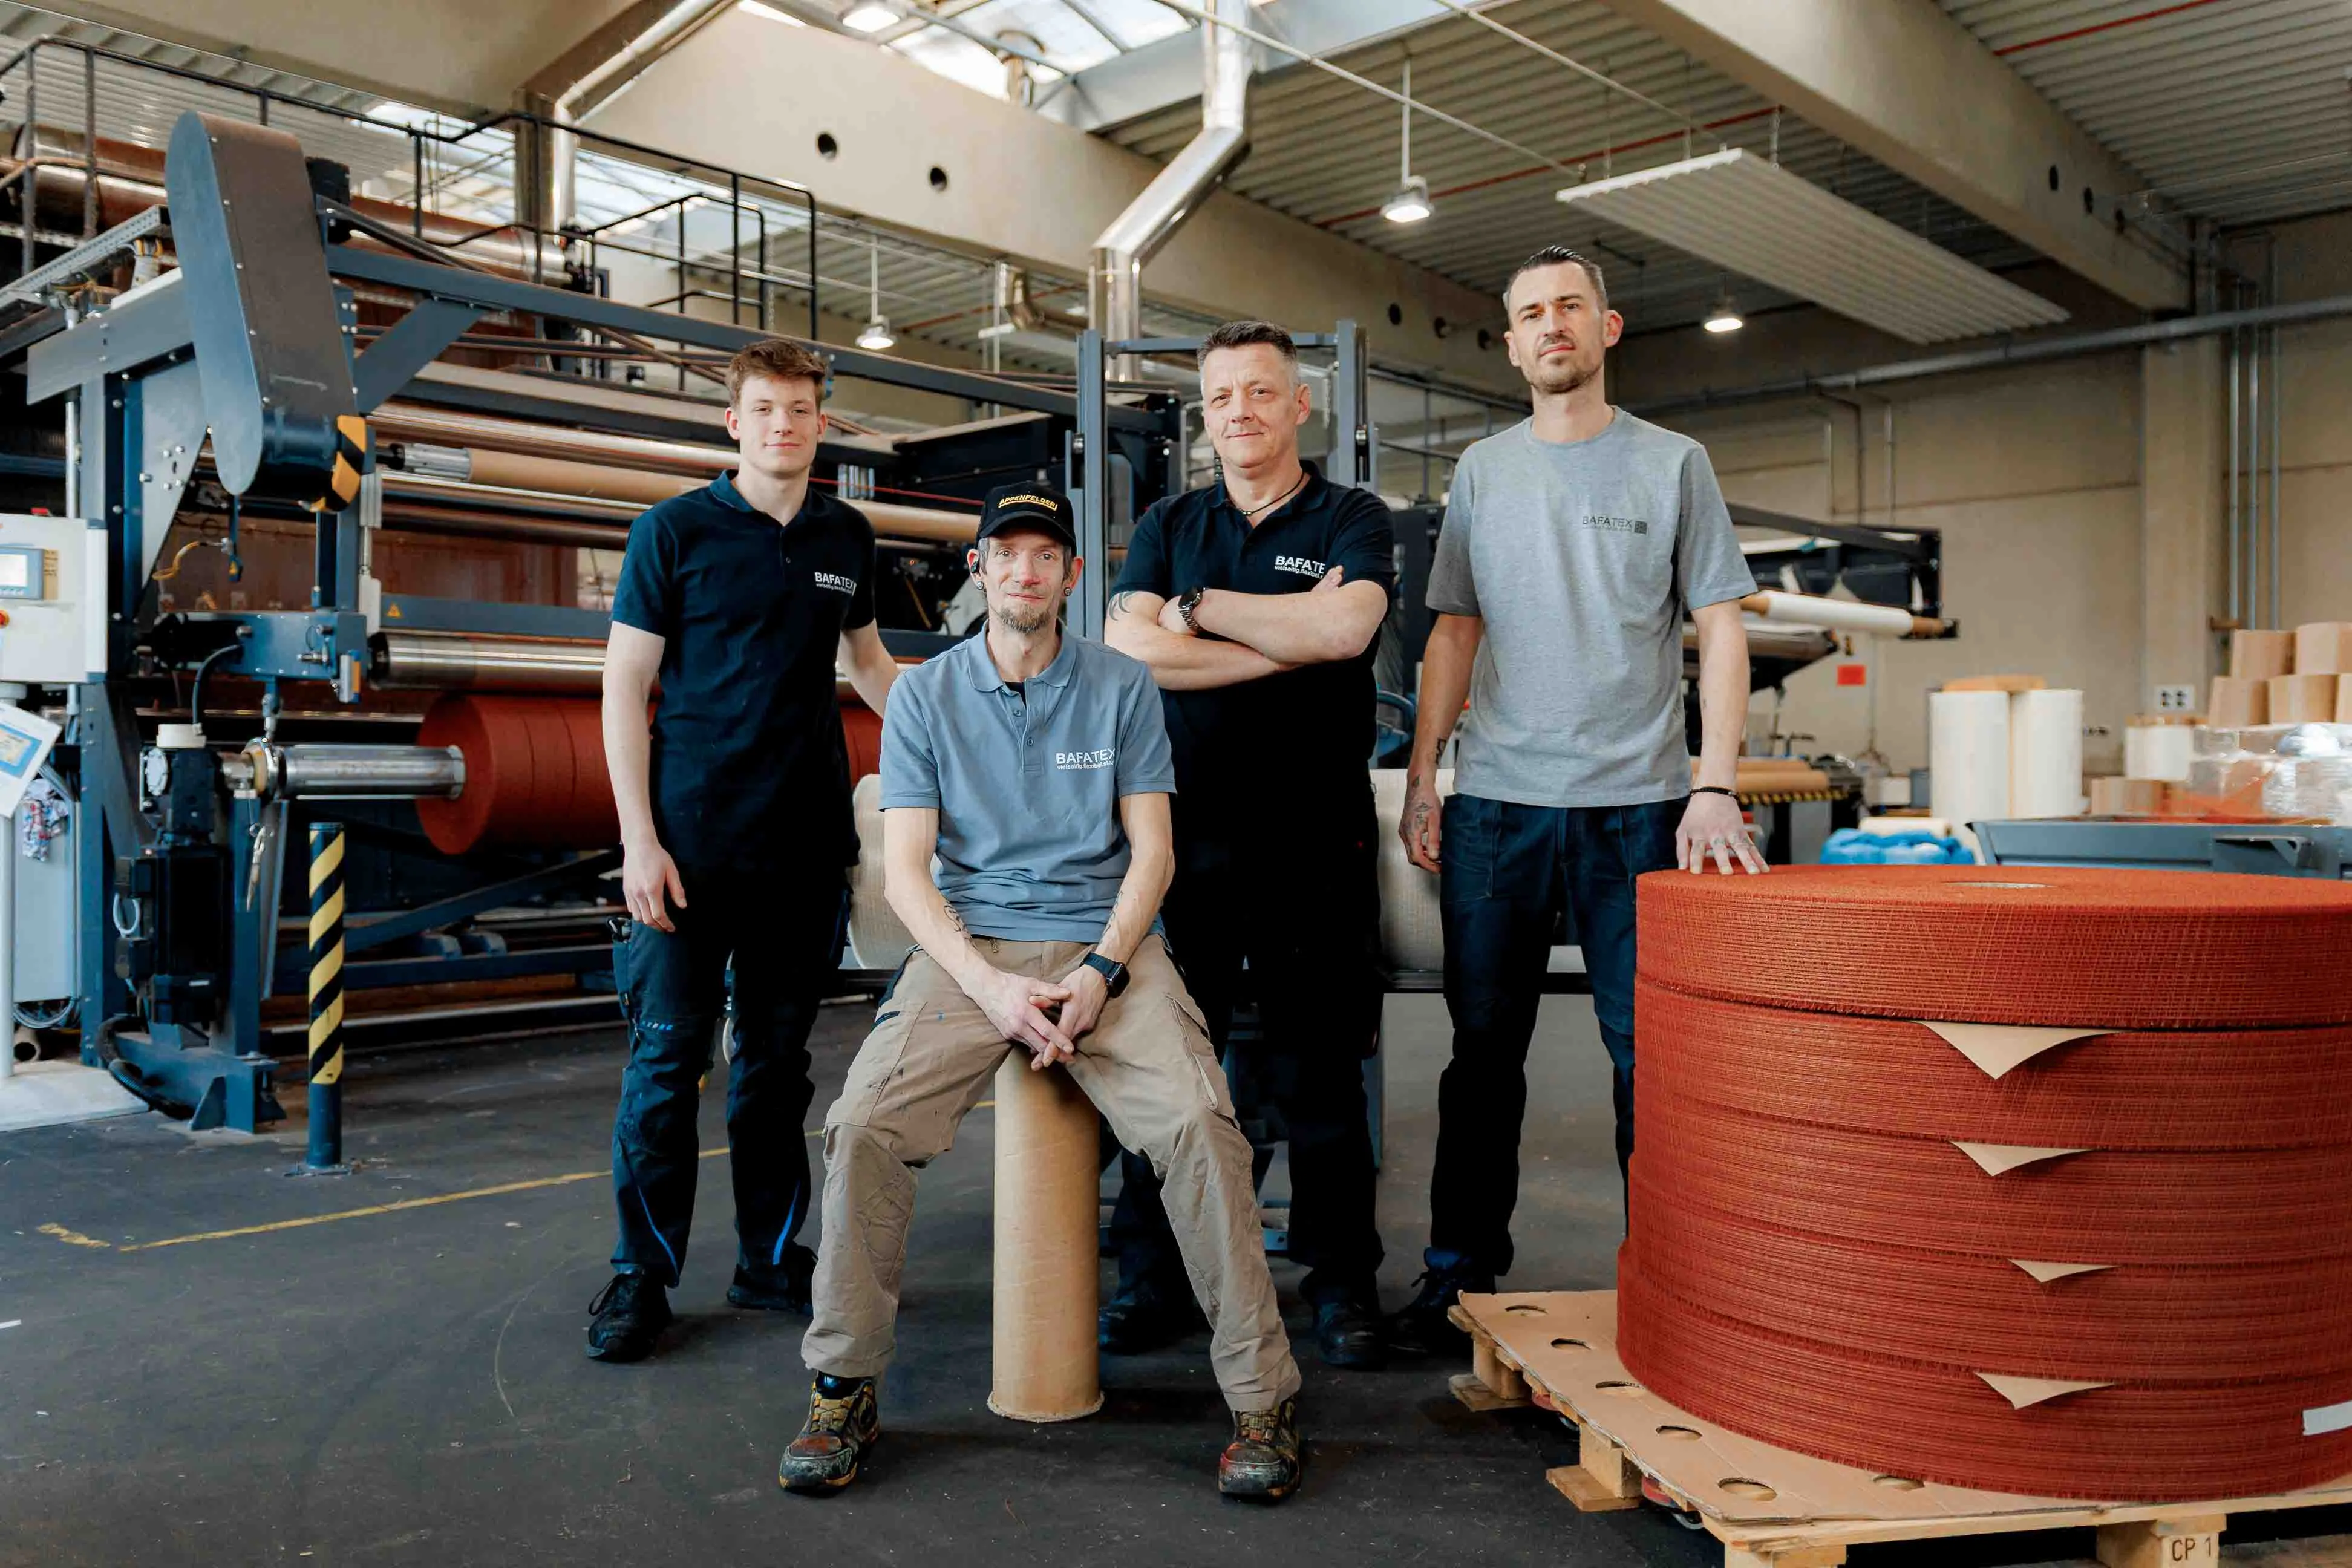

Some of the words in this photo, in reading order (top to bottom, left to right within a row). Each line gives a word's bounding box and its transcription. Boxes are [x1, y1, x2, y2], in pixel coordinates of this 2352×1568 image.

[999, 494, 1056, 508] APPENFELDER
[1583, 516, 1632, 528] BAFATEX
[1275, 555, 1325, 574] BAFATE
[814, 571, 854, 590] BAFATEX
[1056, 748, 1116, 764] BAFATEX
[2172, 1538, 2195, 1561] CP
[2204, 1536, 2211, 1557] 1
